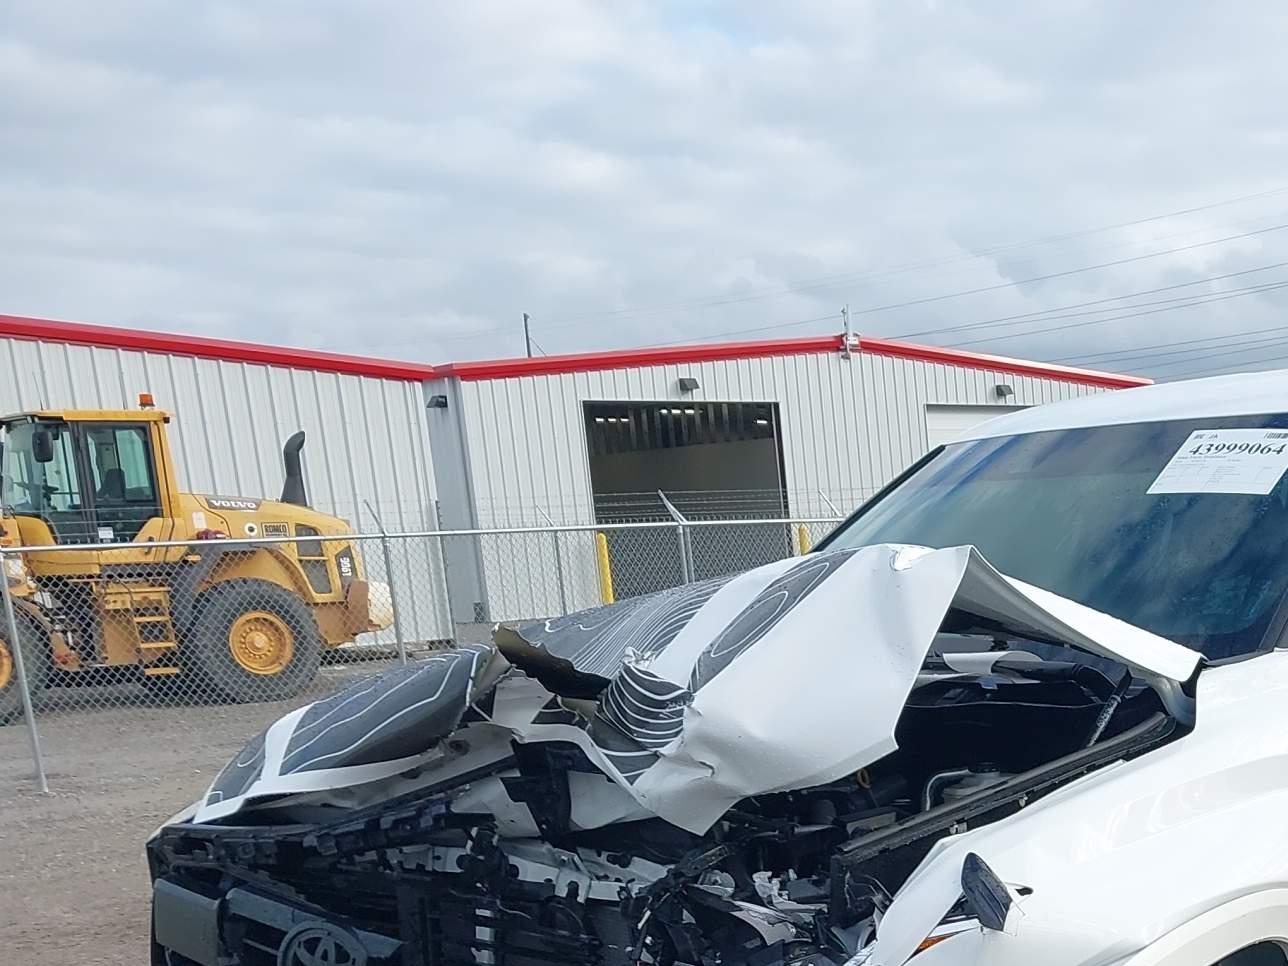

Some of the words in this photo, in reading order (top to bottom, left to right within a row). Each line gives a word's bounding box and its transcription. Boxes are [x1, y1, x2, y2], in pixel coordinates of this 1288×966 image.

[1189, 442, 1288, 456] 43999064
[210, 500, 257, 509] VOLVO
[339, 557, 352, 577] L90G
